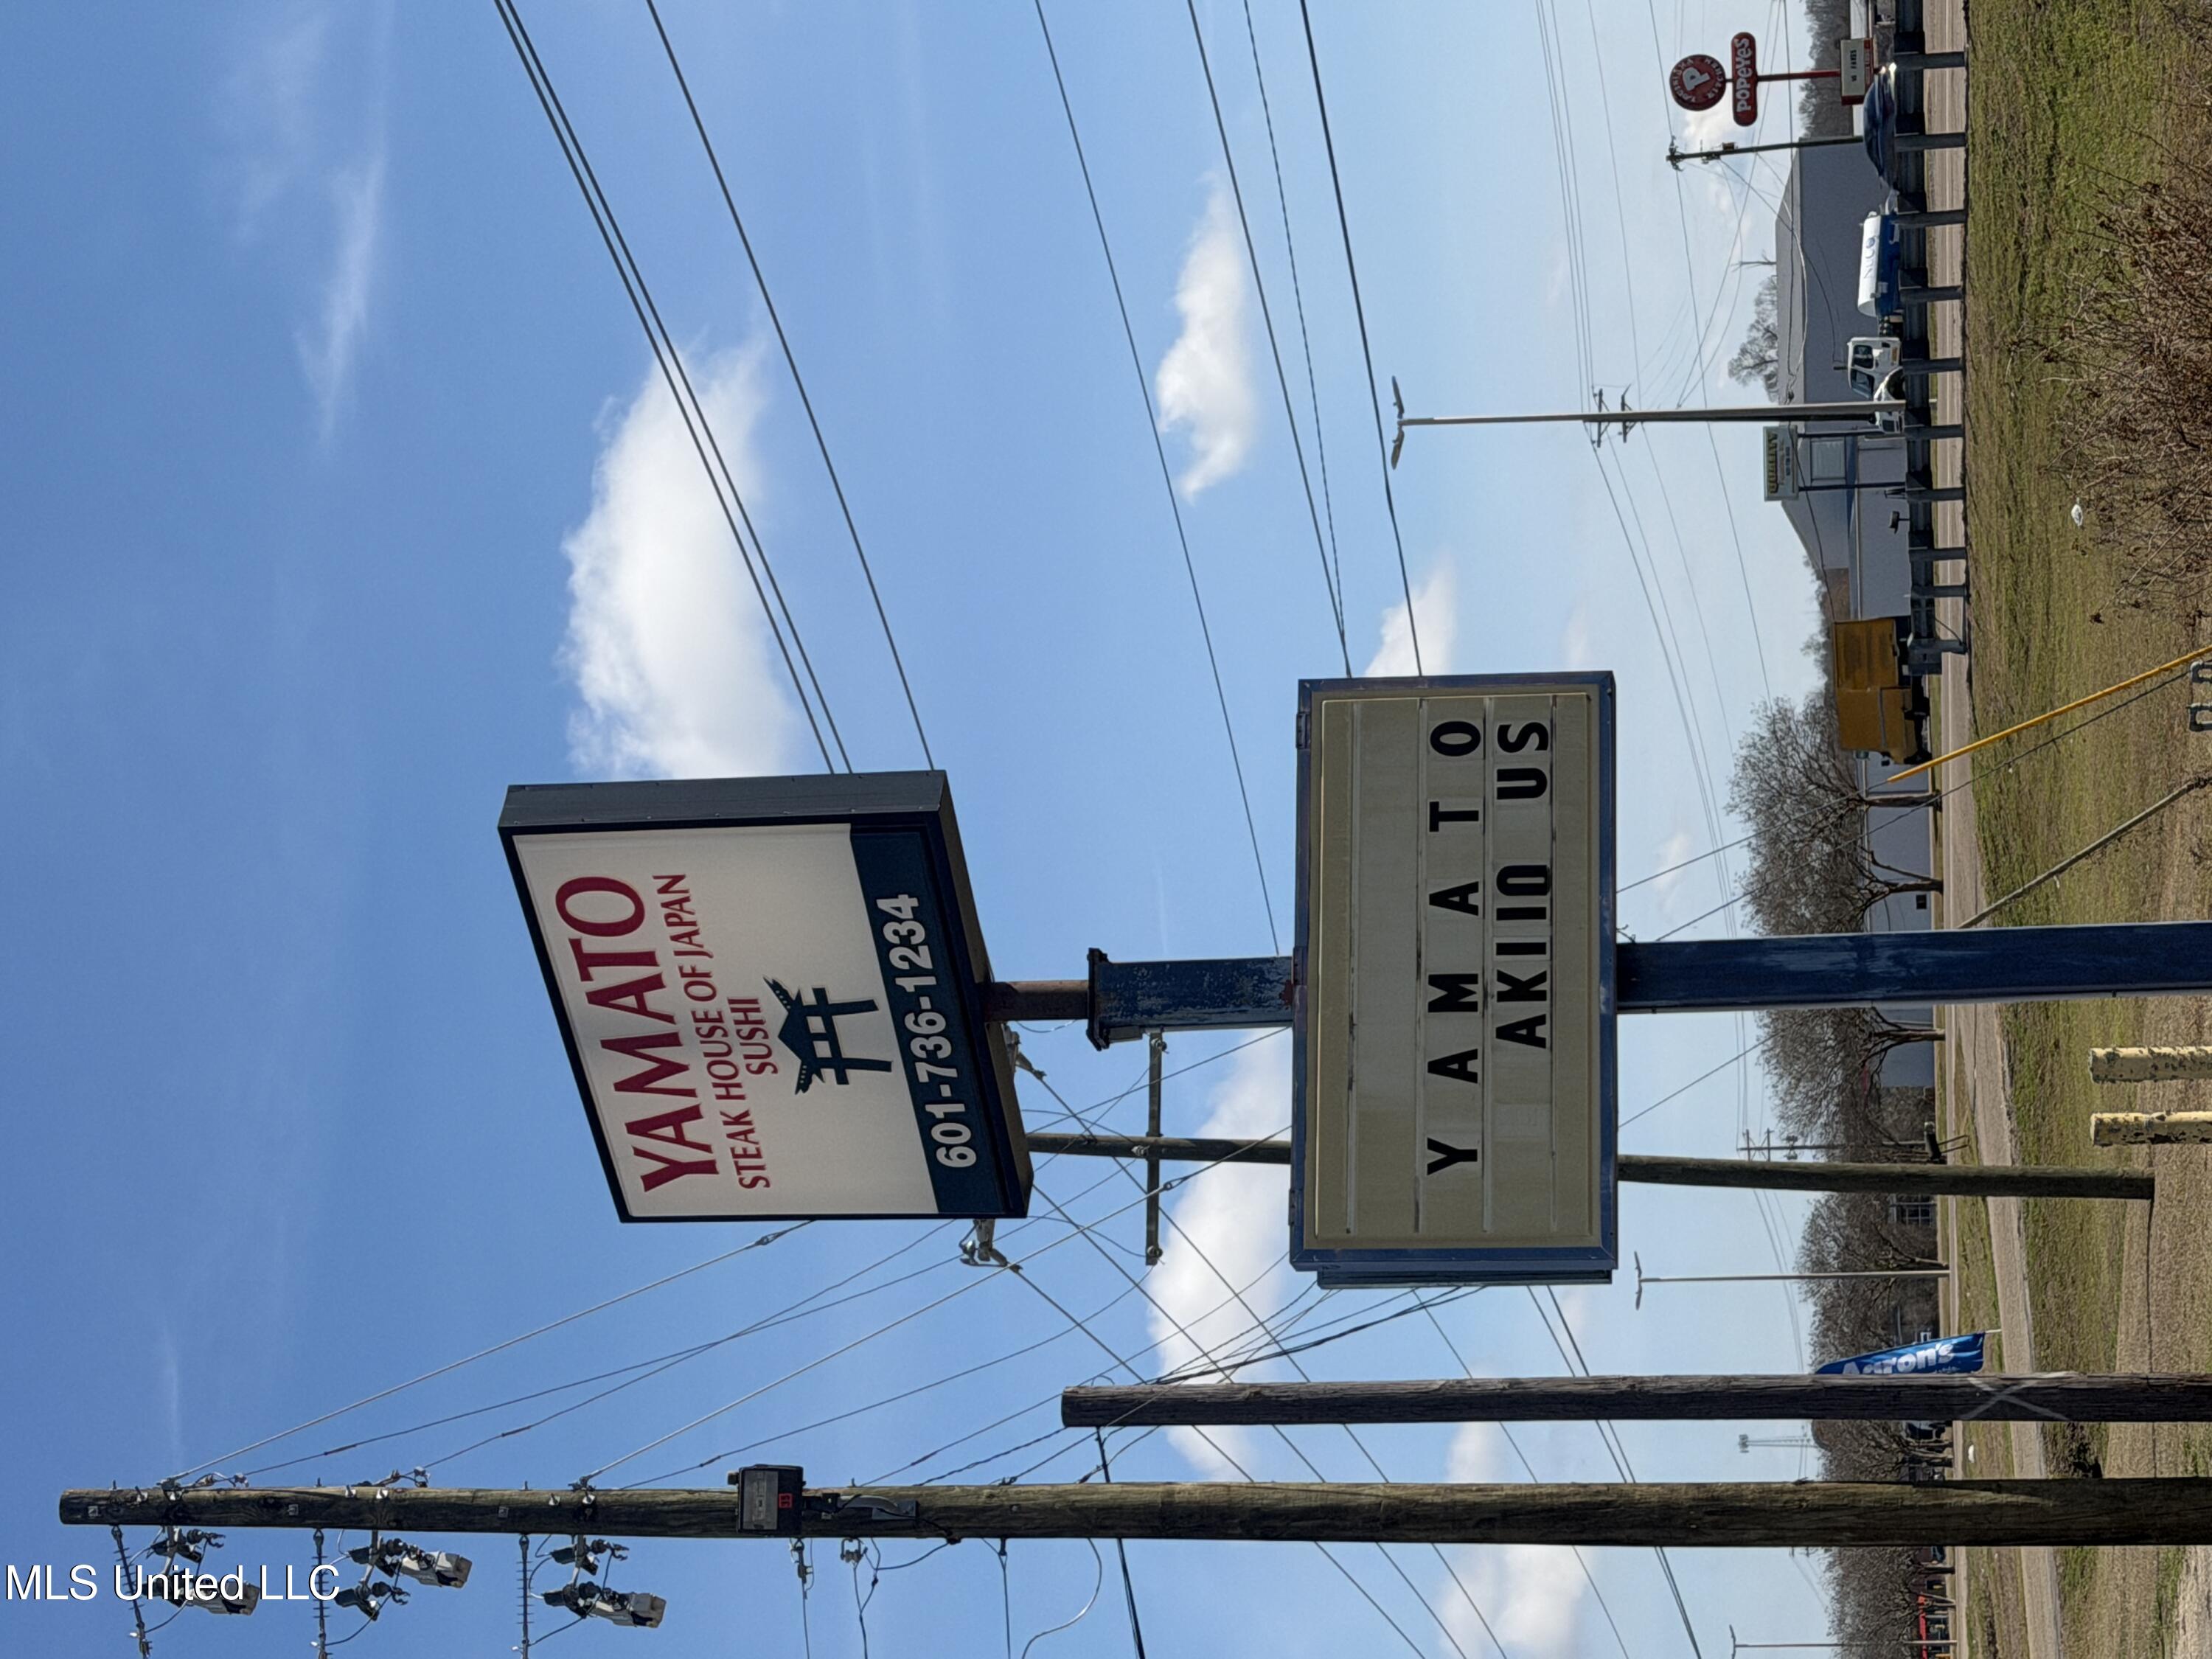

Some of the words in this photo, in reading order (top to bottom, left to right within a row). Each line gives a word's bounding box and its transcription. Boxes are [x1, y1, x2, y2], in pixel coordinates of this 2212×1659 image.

[1682, 66, 1711, 91] P
[1496, 720, 1550, 800] US
[652, 874, 714, 959] JAPAN
[1427, 720, 1481, 1175] YAMATO
[680, 964, 717, 1003] OF
[554, 875, 720, 1192] YAMATO
[690, 1009, 747, 1102] HOUSE
[726, 997, 778, 1075] SUSHI
[876, 893, 977, 1168] 601-736-1234
[719, 1109, 771, 1189] STEAK
